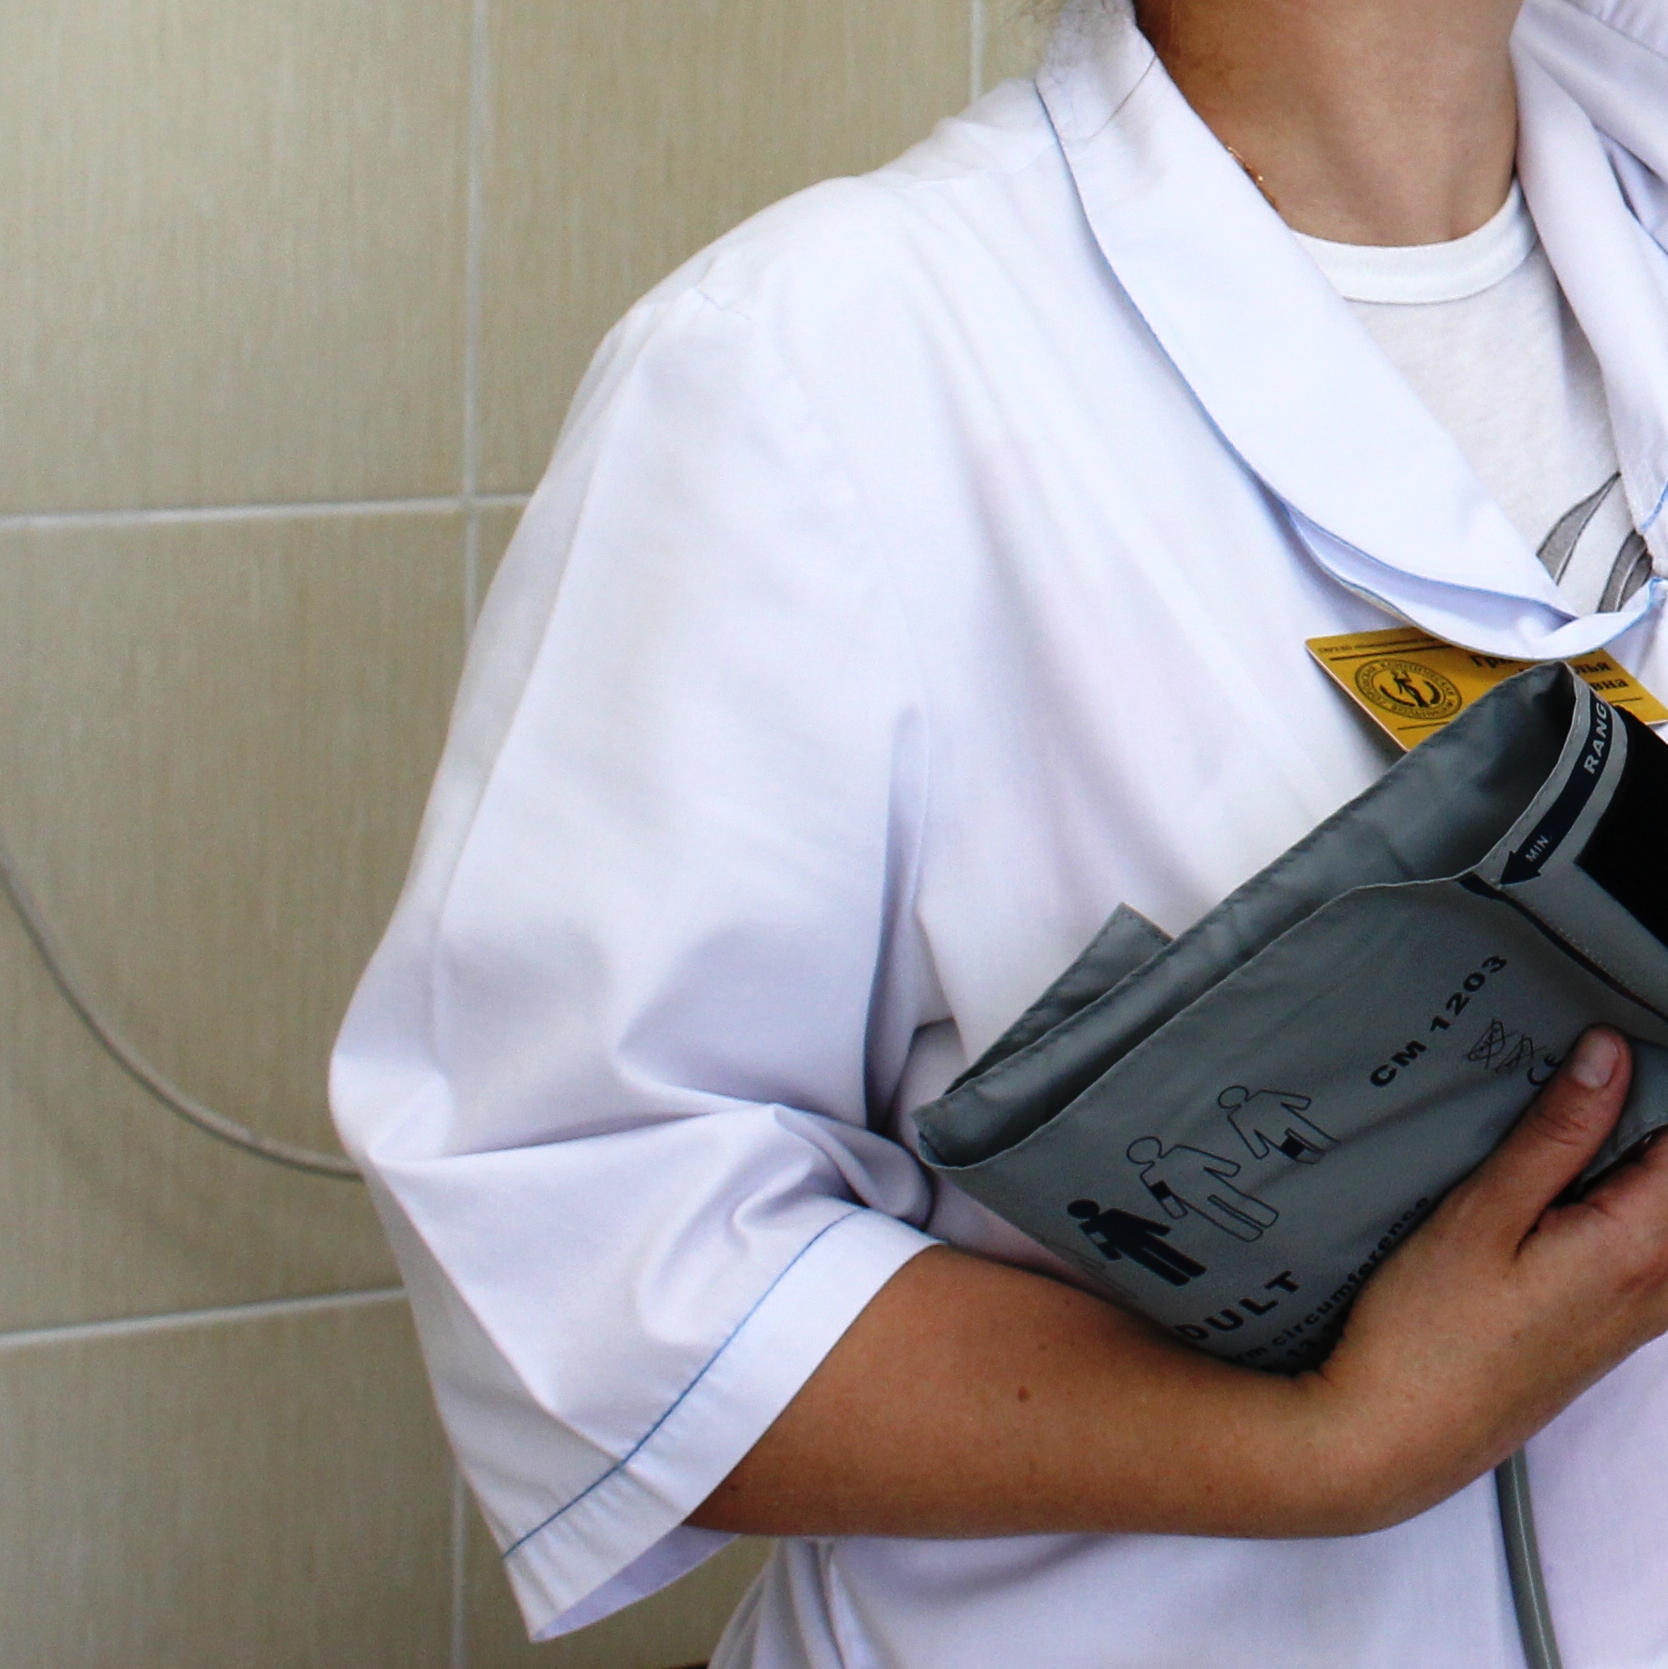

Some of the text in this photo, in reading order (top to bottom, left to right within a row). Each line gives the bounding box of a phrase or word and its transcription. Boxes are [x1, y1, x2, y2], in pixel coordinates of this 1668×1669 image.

[1582, 701, 1610, 775] RANG
[1369, 954, 1508, 1088] CM 1203
[1174, 1269, 1300, 1341] DULT
